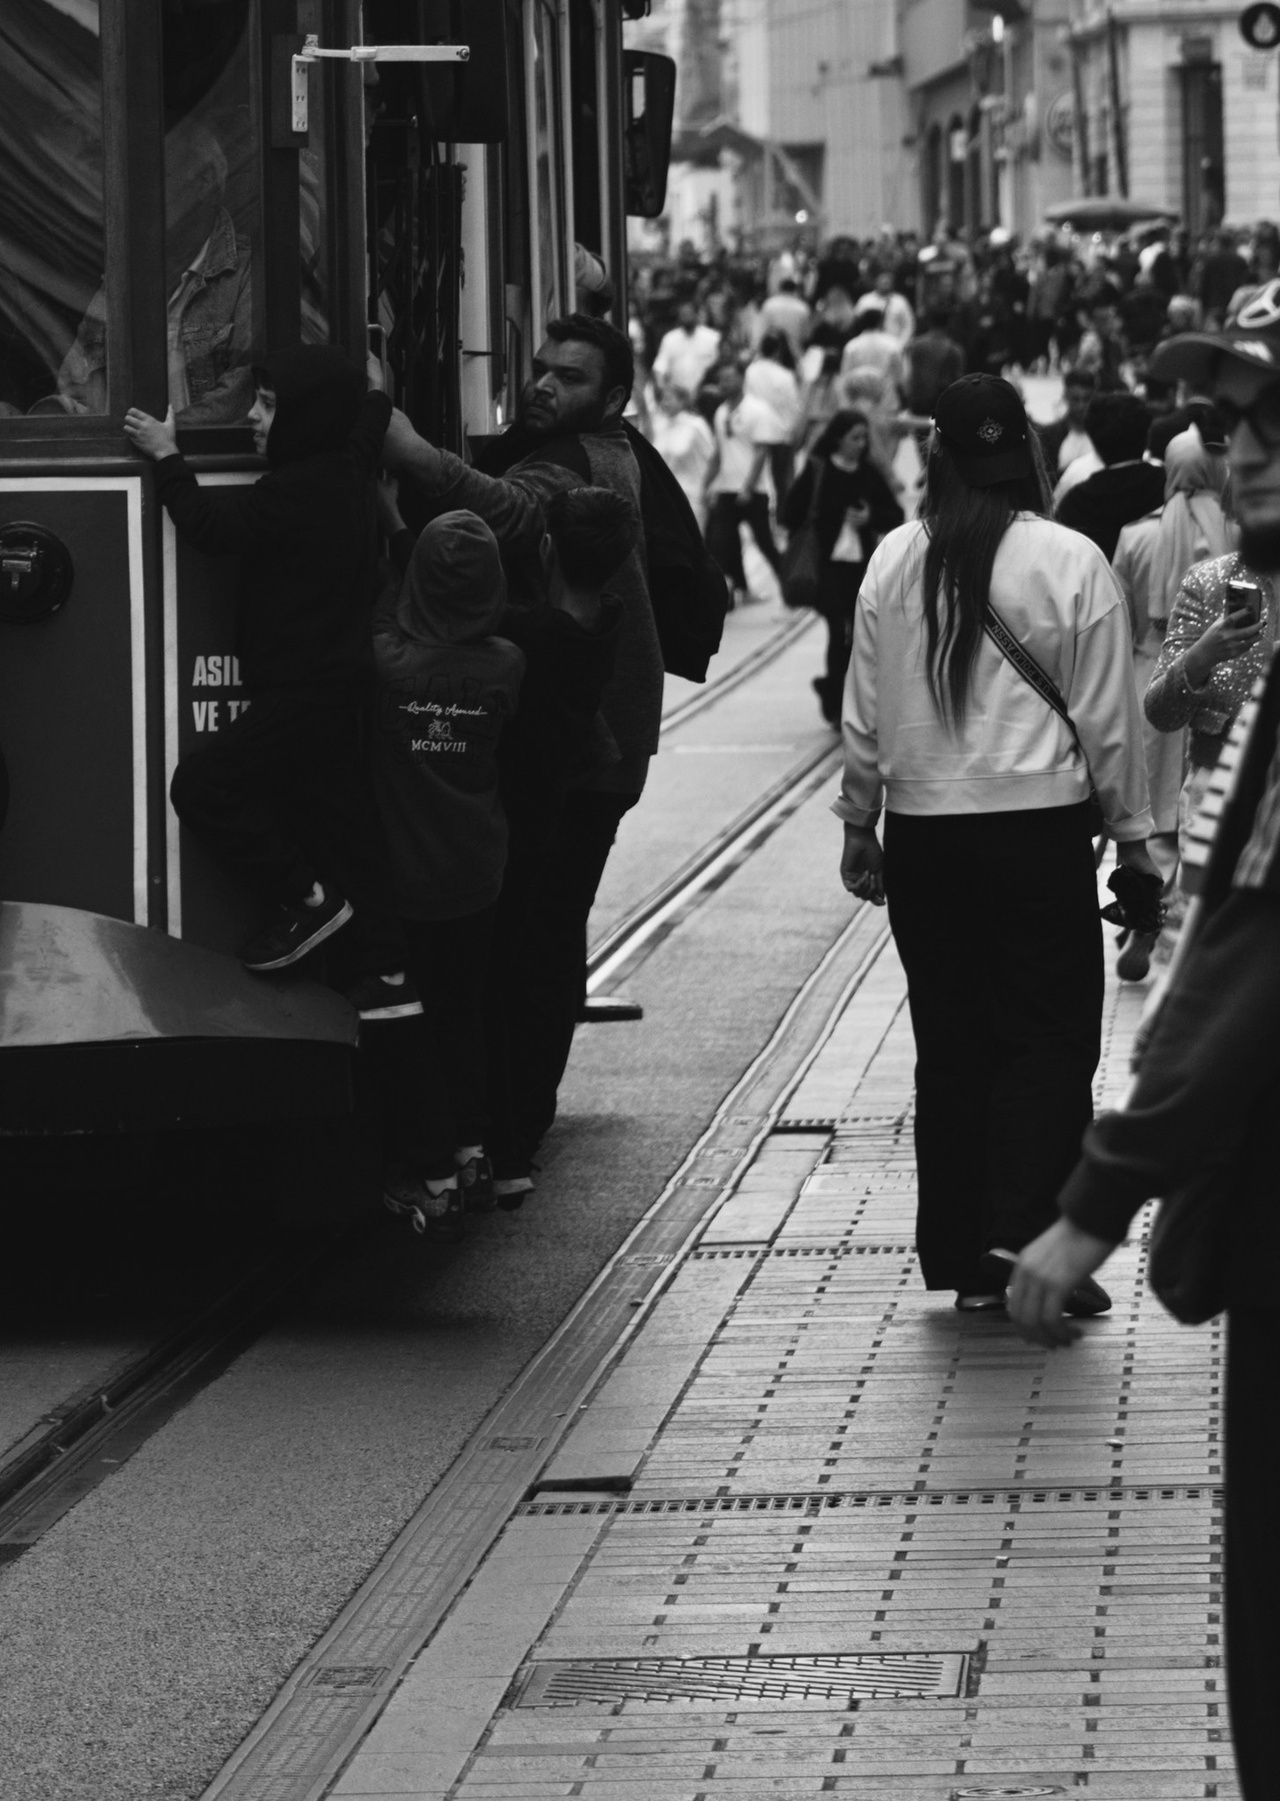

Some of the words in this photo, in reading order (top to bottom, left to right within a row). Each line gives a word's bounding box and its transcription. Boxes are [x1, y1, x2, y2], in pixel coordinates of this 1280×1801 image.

[192, 655, 243, 687] ASIL
[1013, 650, 1037, 679] POLO
[192, 701, 219, 732] VE
[403, 701, 443, 717] Quality
[411, 739, 467, 753] MCMVIII
